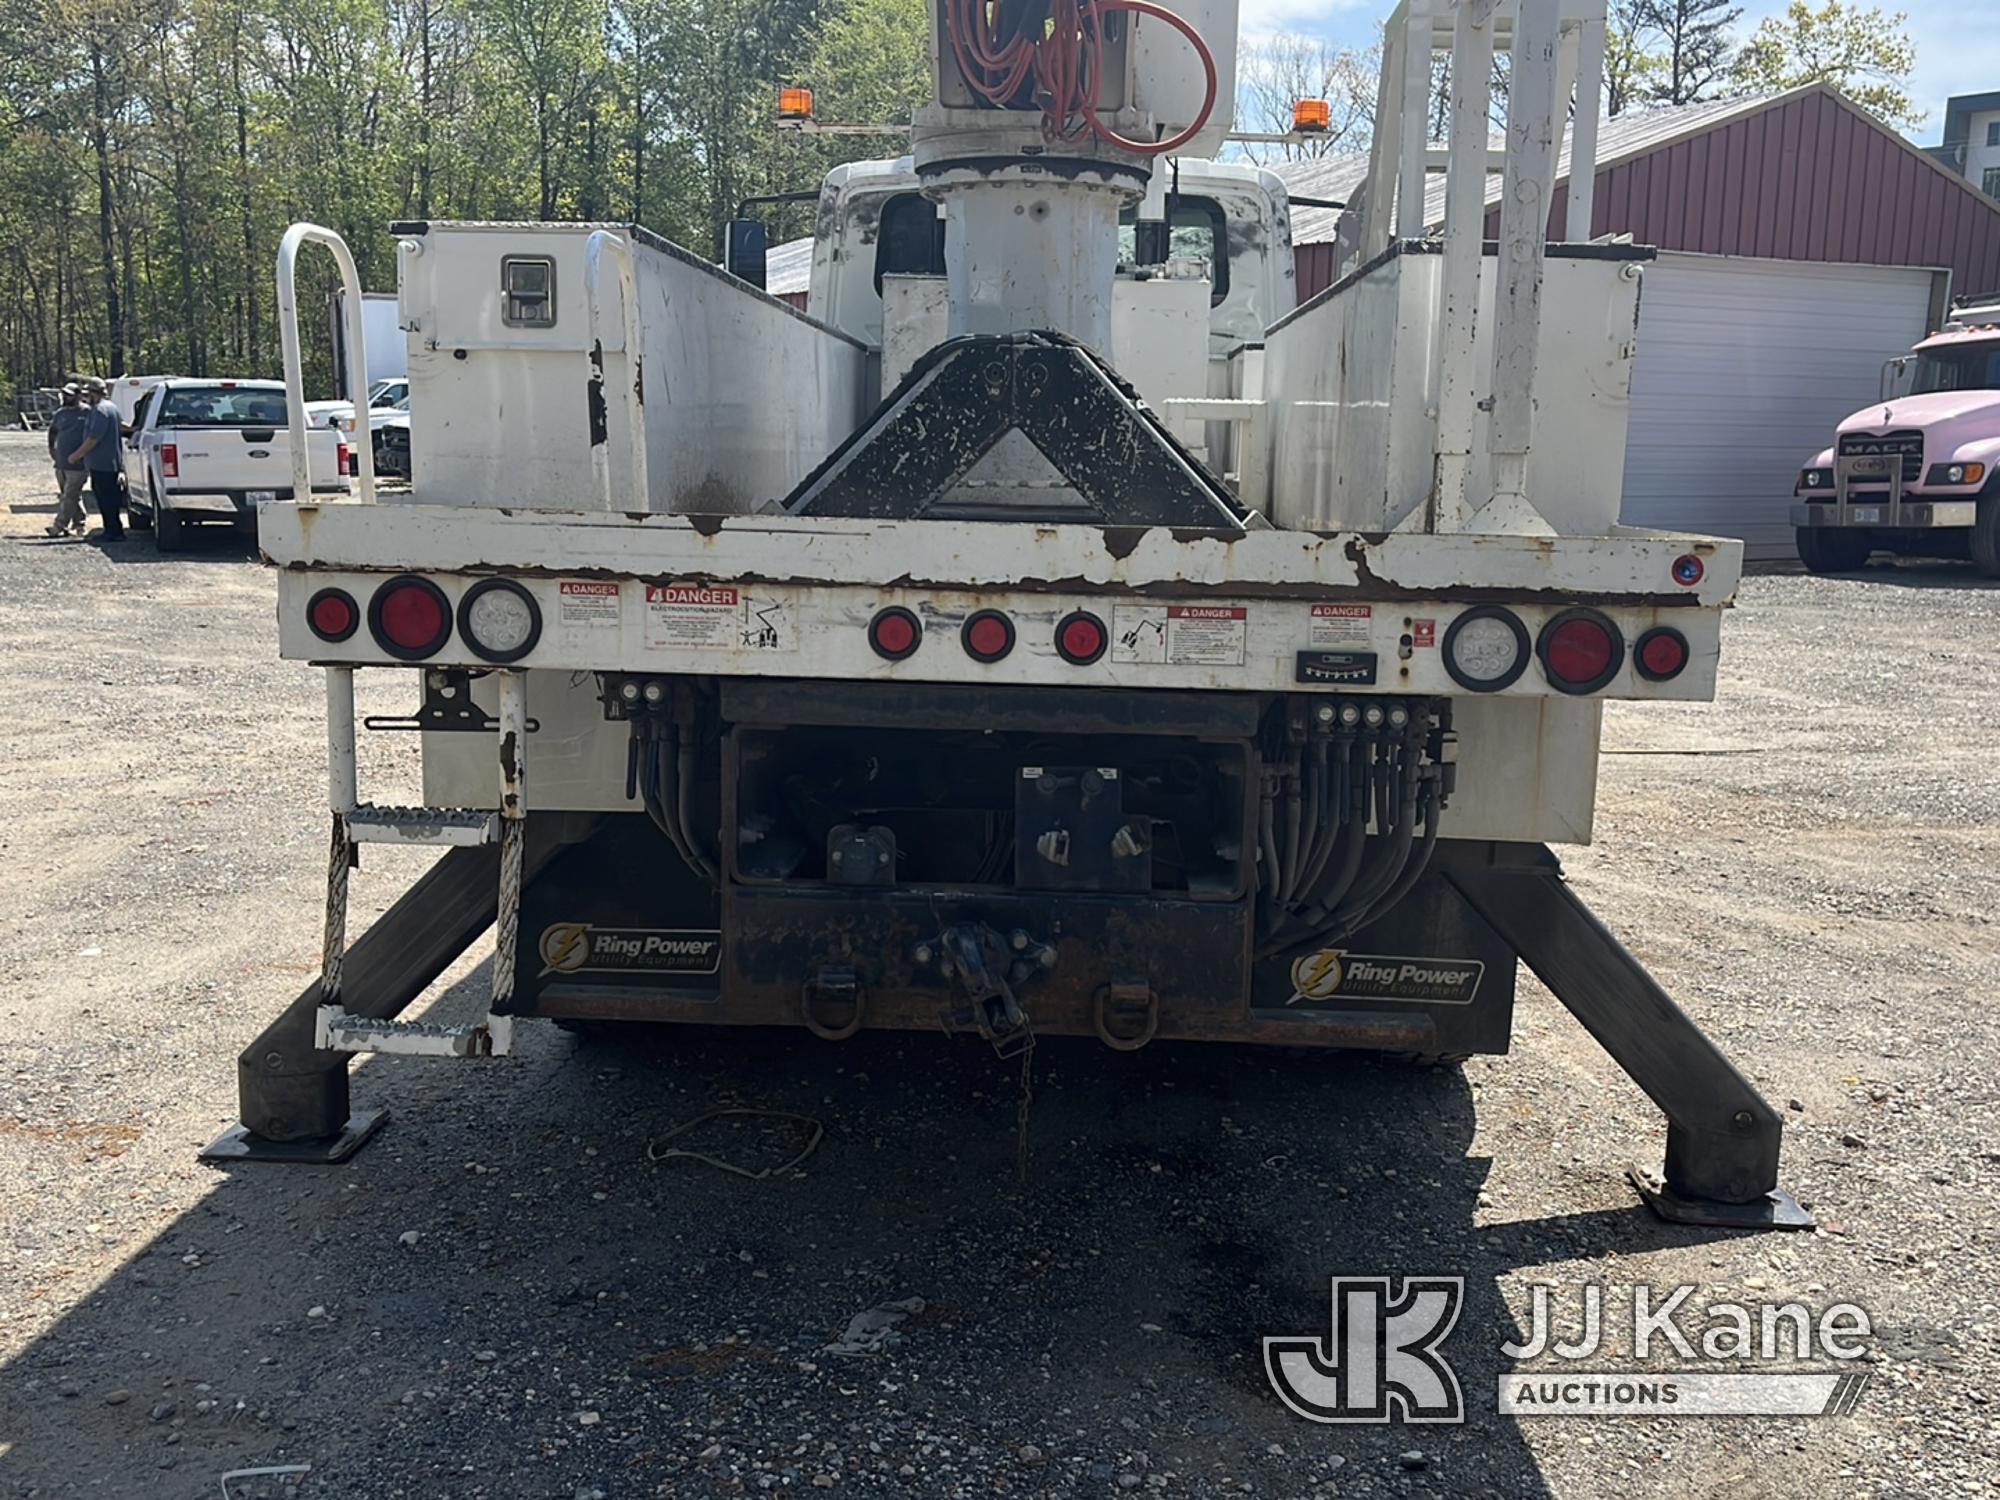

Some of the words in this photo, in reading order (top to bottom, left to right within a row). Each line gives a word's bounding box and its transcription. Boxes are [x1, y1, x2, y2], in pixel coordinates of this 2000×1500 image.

[1845, 444, 1918, 453] MACK
[572, 584, 617, 594] DANGER
[666, 588, 733, 603] DANGER
[1191, 608, 1232, 618] DANGER
[1323, 606, 1368, 616] DANGER
[594, 935, 642, 957] Ring
[643, 936, 713, 955] Power
[591, 953, 632, 965] Utility
[638, 954, 709, 967] Equipment
[1347, 962, 1396, 984] Ring
[1399, 965, 1469, 985] Power
[1390, 983, 1465, 996] Equipment
